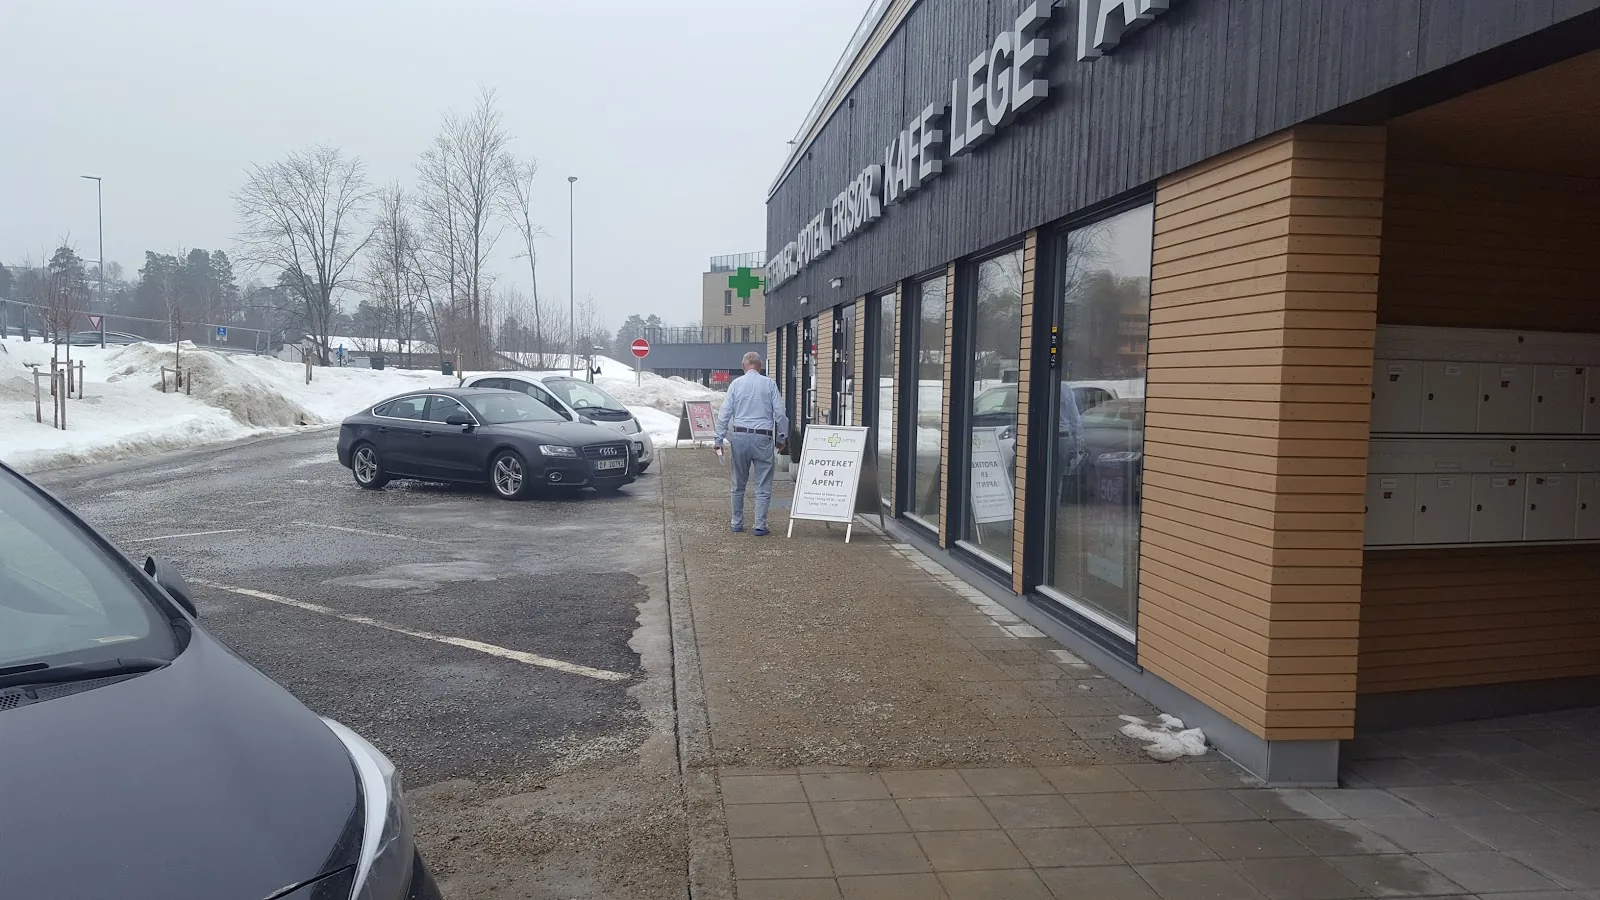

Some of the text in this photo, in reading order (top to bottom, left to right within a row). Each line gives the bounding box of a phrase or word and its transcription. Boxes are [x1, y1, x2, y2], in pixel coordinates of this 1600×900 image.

[796, 207, 832, 270] APOTEK
[831, 164, 882, 246] FRISØR
[884, 101, 944, 206] KAFE
[950, 0, 1052, 157] LEGE
[808, 459, 853, 467] APOTEKET
[812, 477, 843, 487] ÅPENT!
